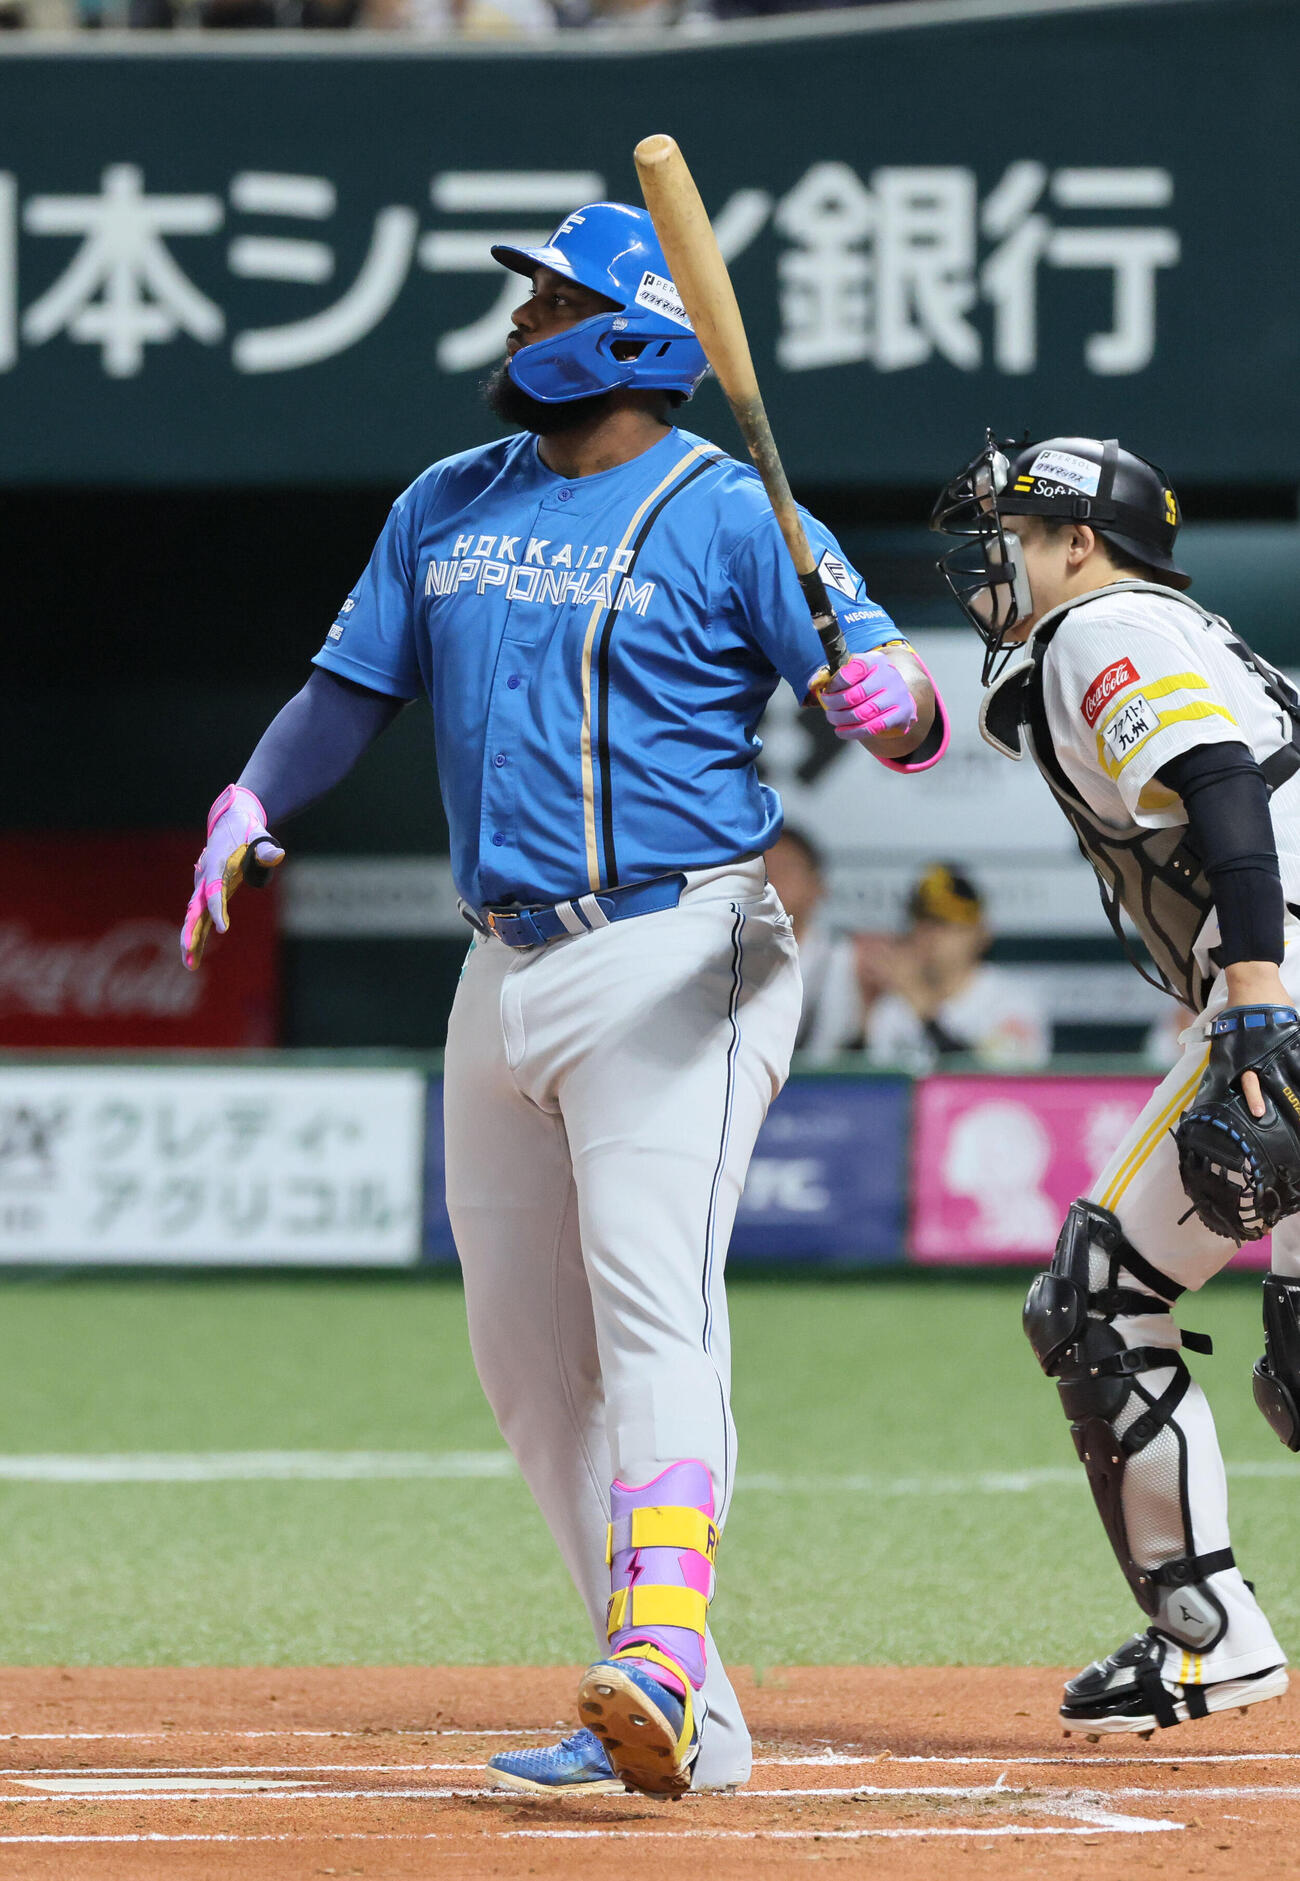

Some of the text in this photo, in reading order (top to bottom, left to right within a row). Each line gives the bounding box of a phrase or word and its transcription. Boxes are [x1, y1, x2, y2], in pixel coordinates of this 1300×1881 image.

[452, 534, 636, 574] HOKKAIDO
[424, 558, 656, 617] NIPPONHAM
[1085, 661, 1131, 721] Coca-Cola
[1118, 718, 1149, 752] 九州
